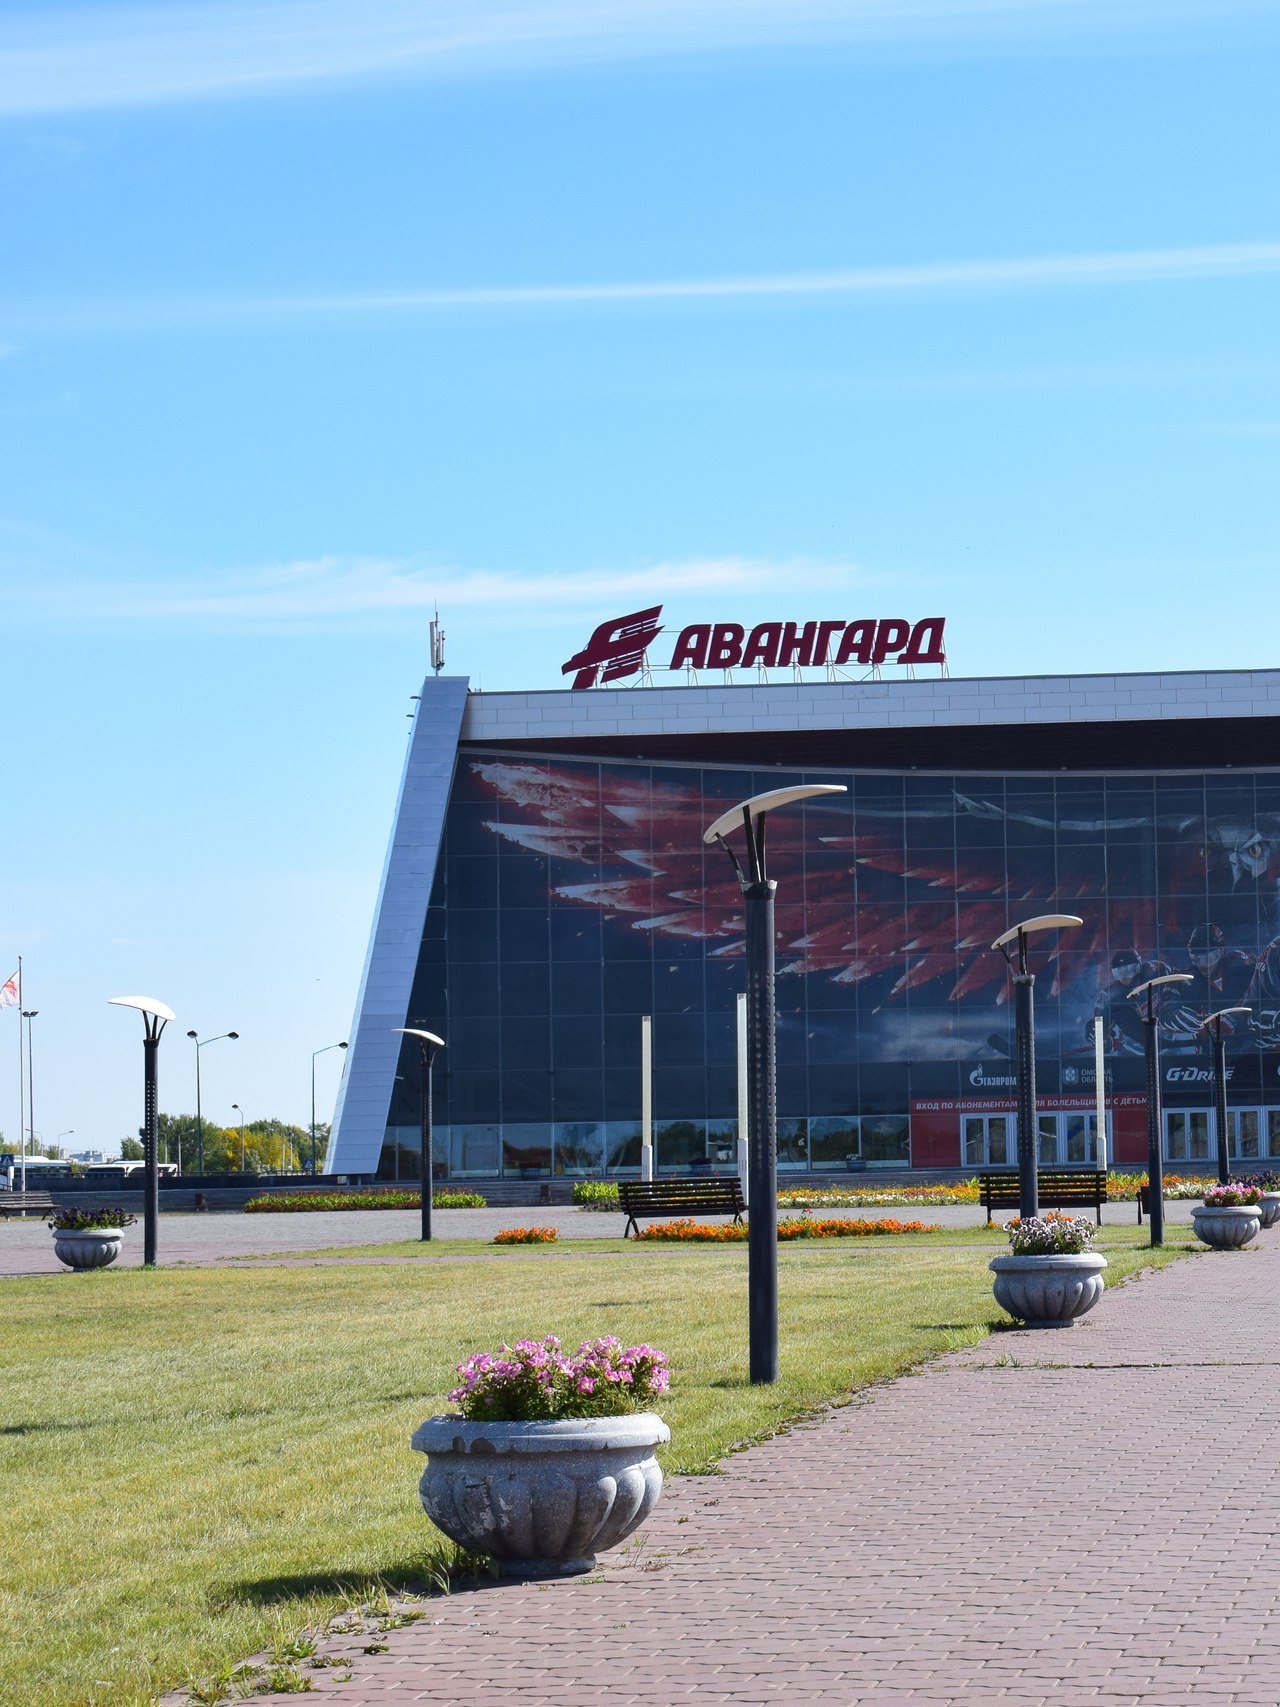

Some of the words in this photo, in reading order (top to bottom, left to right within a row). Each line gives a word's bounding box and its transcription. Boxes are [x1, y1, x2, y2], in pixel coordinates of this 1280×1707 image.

[669, 617, 946, 670] АВАНГАРД
[916, 1102, 939, 1110] ВХОД
[955, 1100, 1018, 1109] АБОНЕМЕНТАМ
[1113, 1097, 1119, 1105] С
